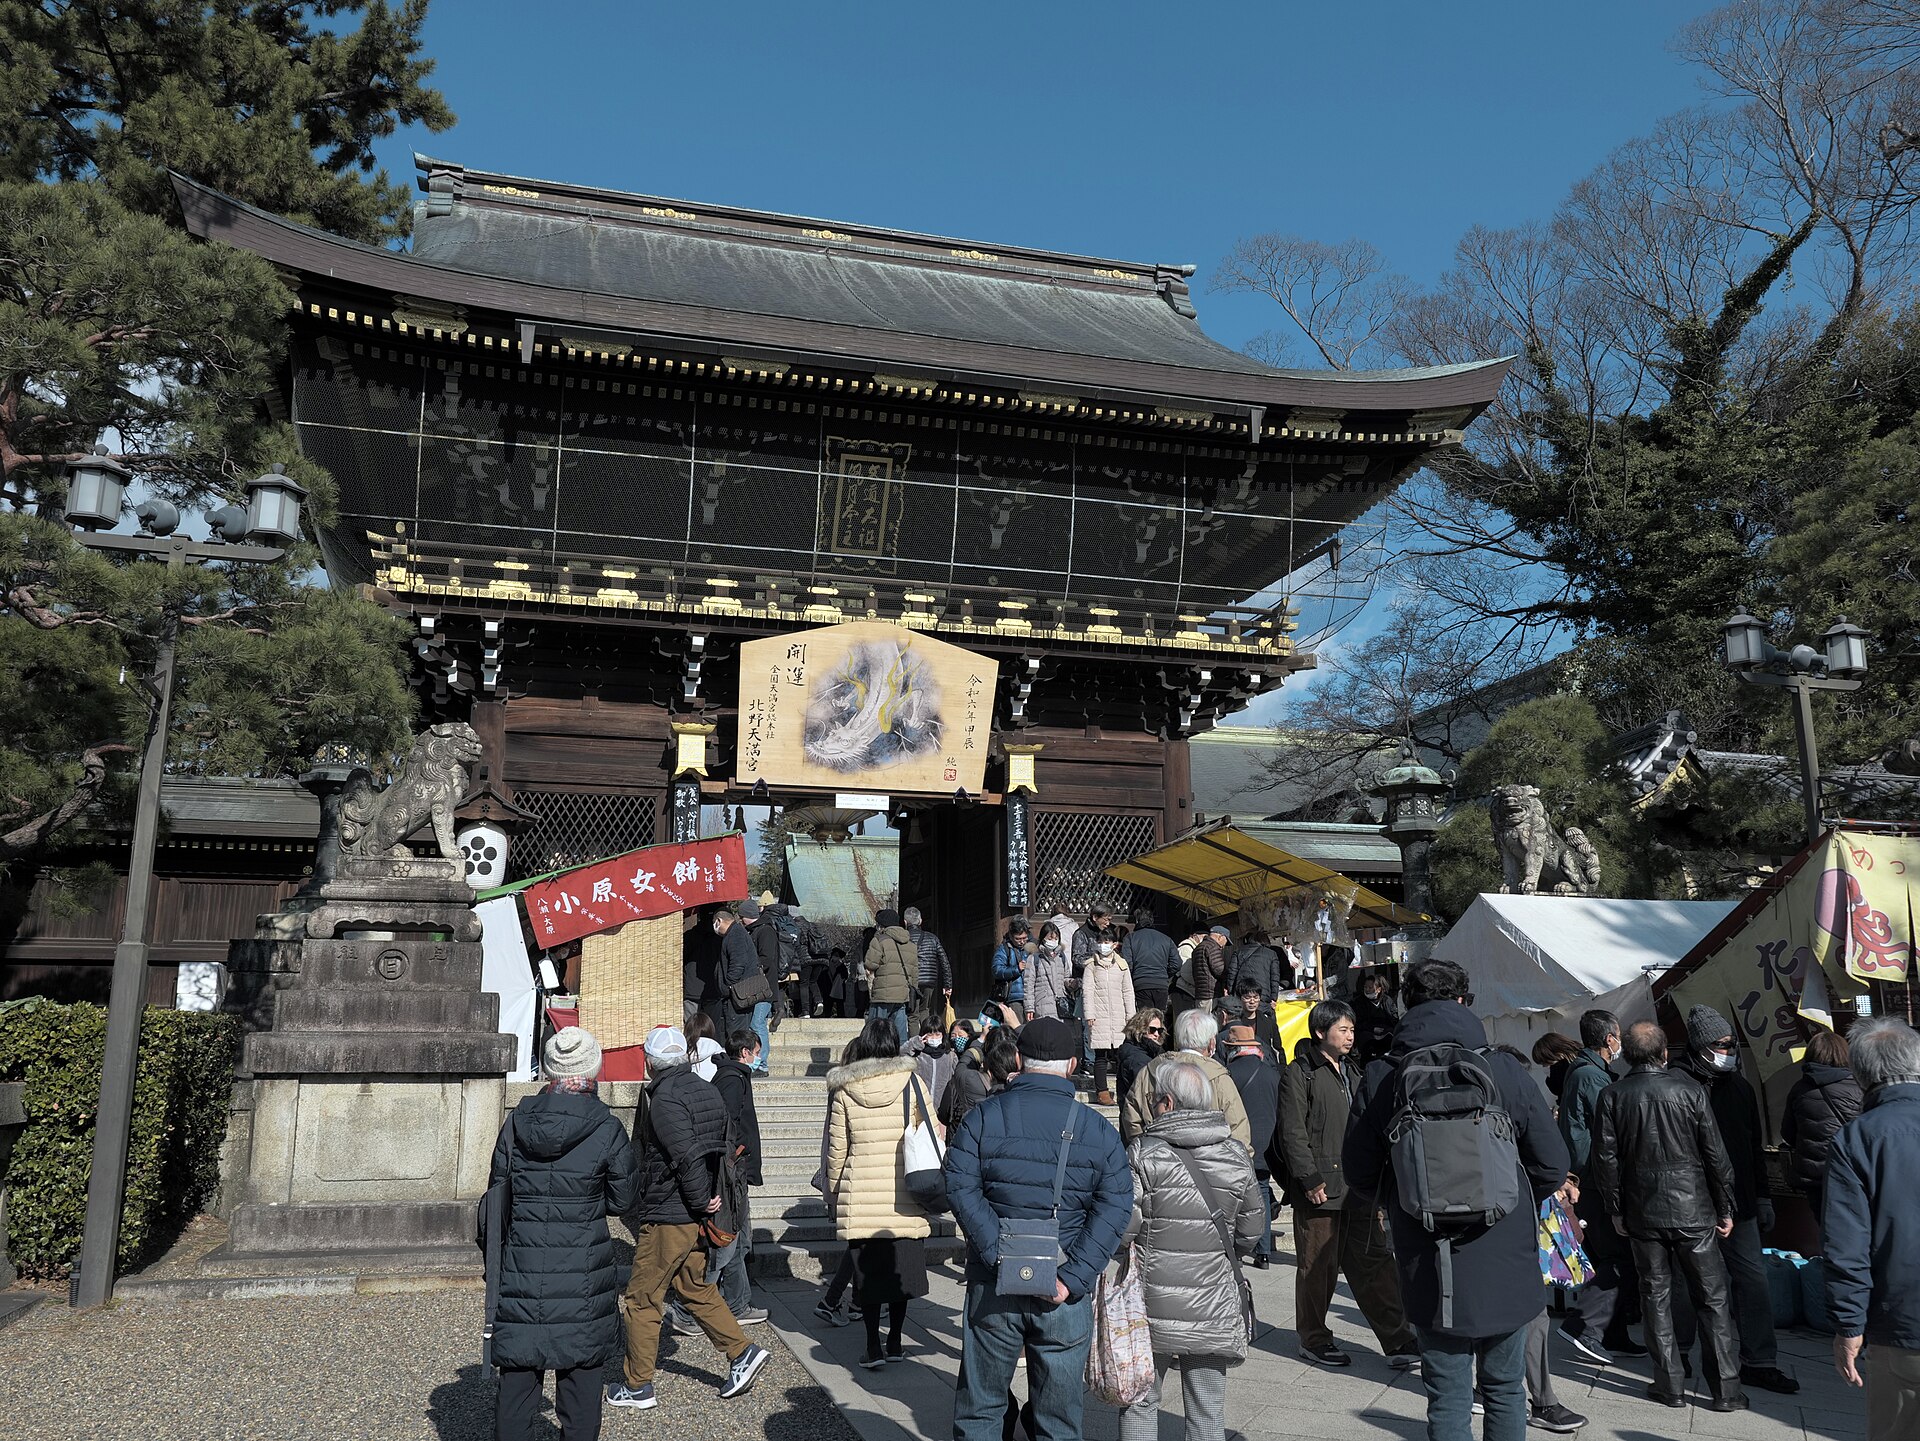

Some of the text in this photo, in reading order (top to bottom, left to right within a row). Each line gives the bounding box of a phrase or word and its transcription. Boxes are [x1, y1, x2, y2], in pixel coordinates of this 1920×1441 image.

[786, 643, 807, 687] 開運
[765, 664, 781, 740] 全国天満宮総本社
[963, 673, 983, 750] 令和六年甲辰
[745, 698, 765, 772] 北野天満宮
[554, 857, 701, 915] 小原女餅
[703, 867, 715, 893] しば漬
[714, 853, 726, 882] 自家製
